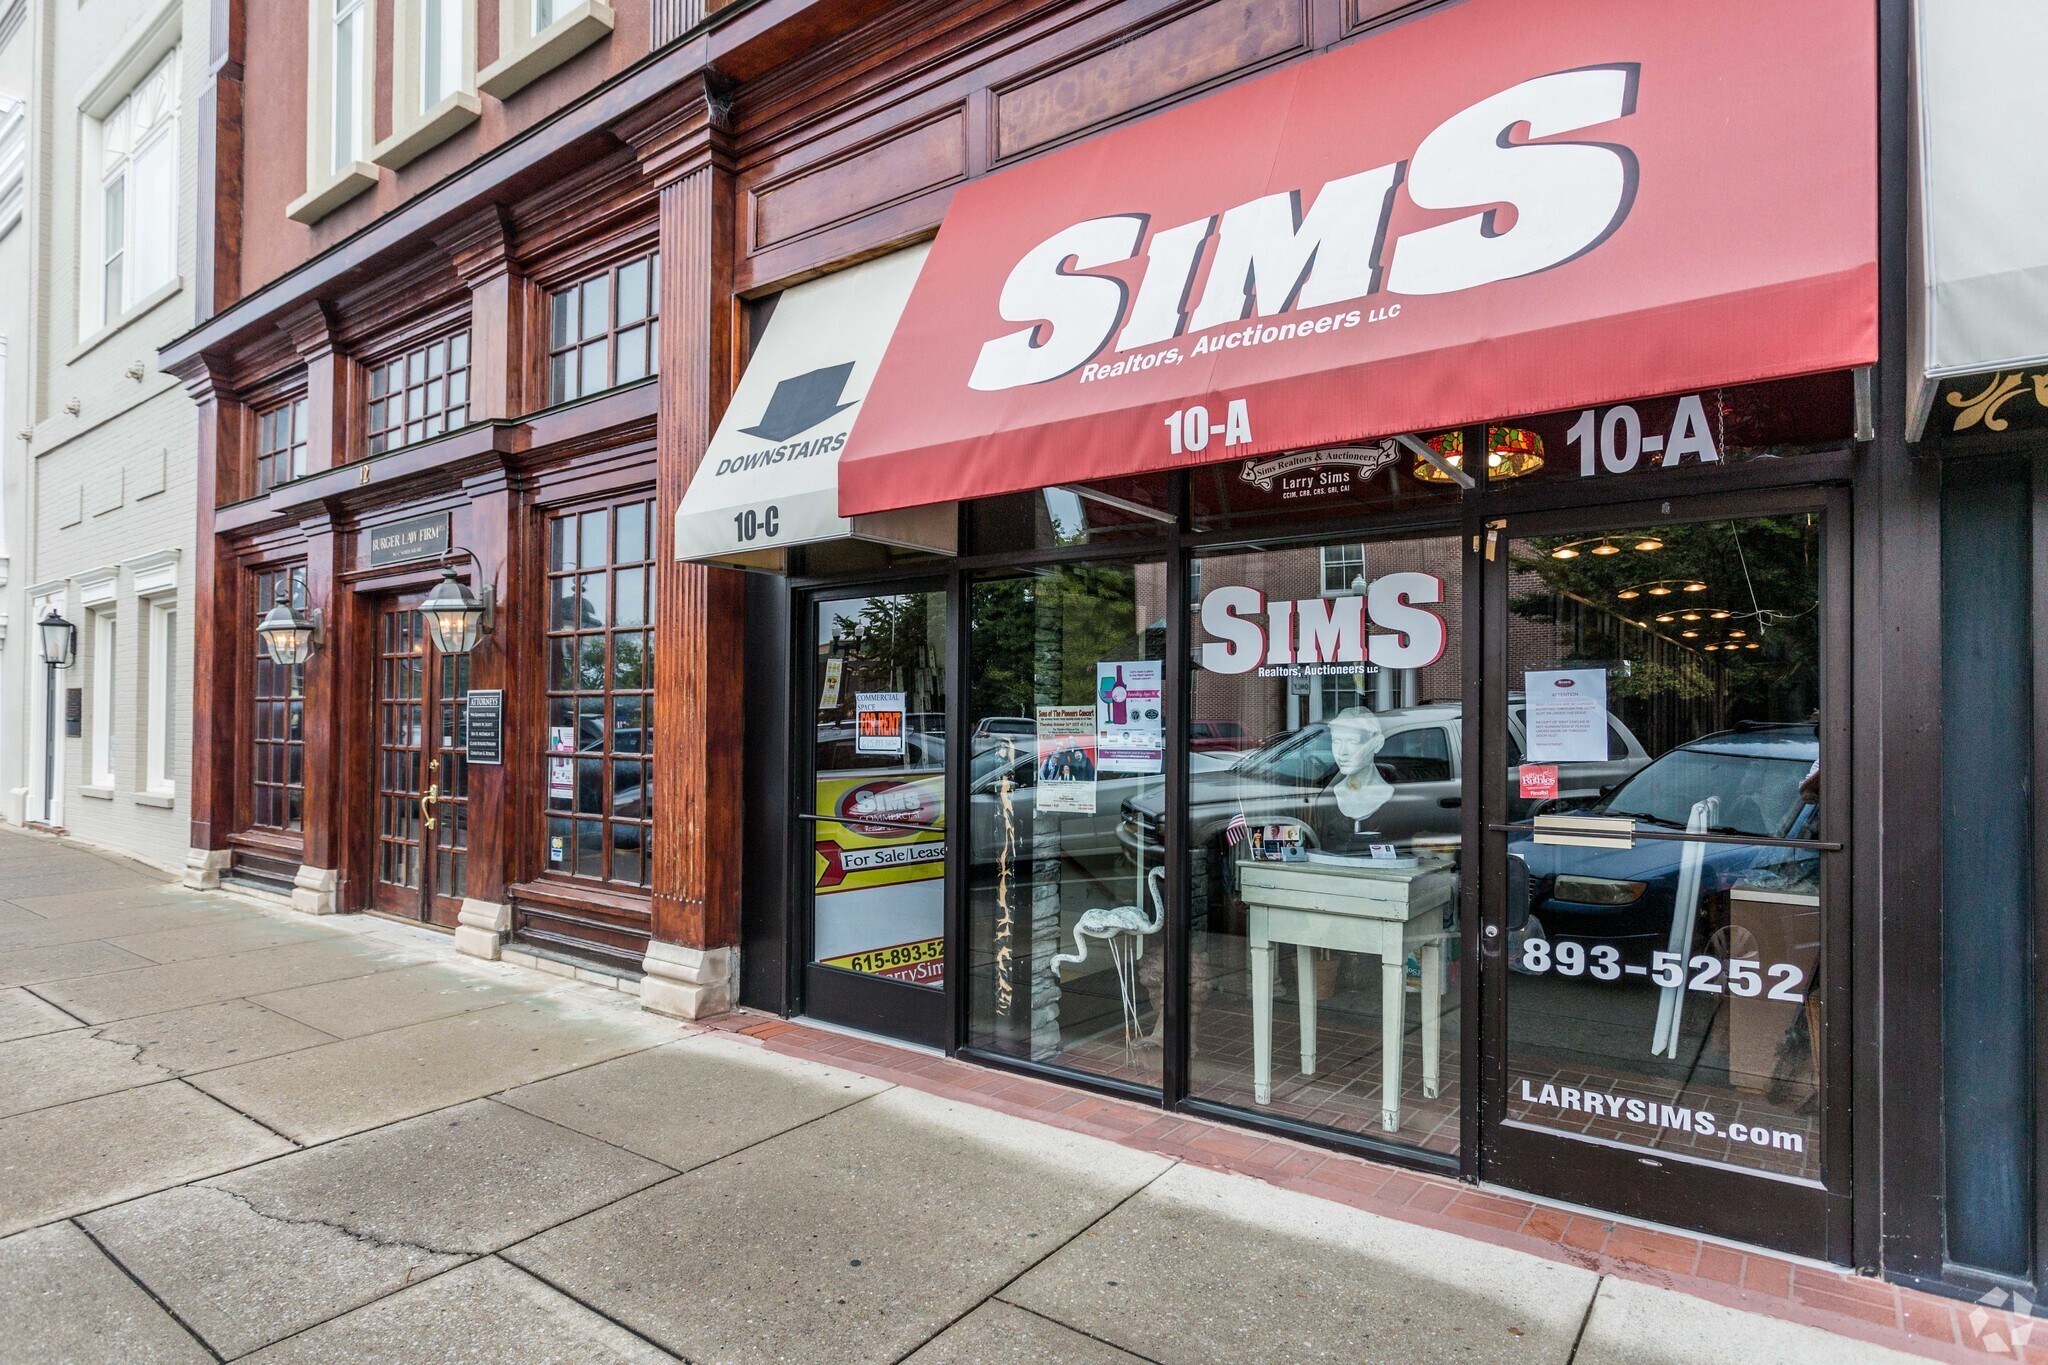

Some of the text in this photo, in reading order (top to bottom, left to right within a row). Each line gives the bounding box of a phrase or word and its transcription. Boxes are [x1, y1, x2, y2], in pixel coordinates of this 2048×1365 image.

[967, 62, 1641, 391] SIMS
[1079, 303, 1401, 383] Realtors, Auctioneers LLC
[1164, 398, 1252, 455] 10-A
[1567, 394, 1719, 477] 10-A
[715, 432, 847, 477] DOWNSTAIRS
[1256, 452, 1377, 478] Sims Realtors & Auctioneers
[1282, 472, 1350, 490] Larry Sims
[372, 534, 401, 551] BURGER
[401, 529, 417, 545] LAW
[419, 525, 439, 542] FIRM
[734, 505, 779, 542] 10-C
[1202, 572, 1447, 674] SIMS
[1304, 664, 1365, 676] Auctioneers
[1366, 666, 1379, 674] LLC
[470, 697, 499, 706] ATTORNEYS
[857, 694, 900, 702] COMMERCIAL
[860, 712, 901, 736] FOR RENT
[855, 790, 920, 813] SIMS
[844, 847, 945, 868] For Sale/Lease
[1522, 938, 1804, 1003] 893-5252
[1521, 1080, 1804, 1152] LARRYSIMS.com
